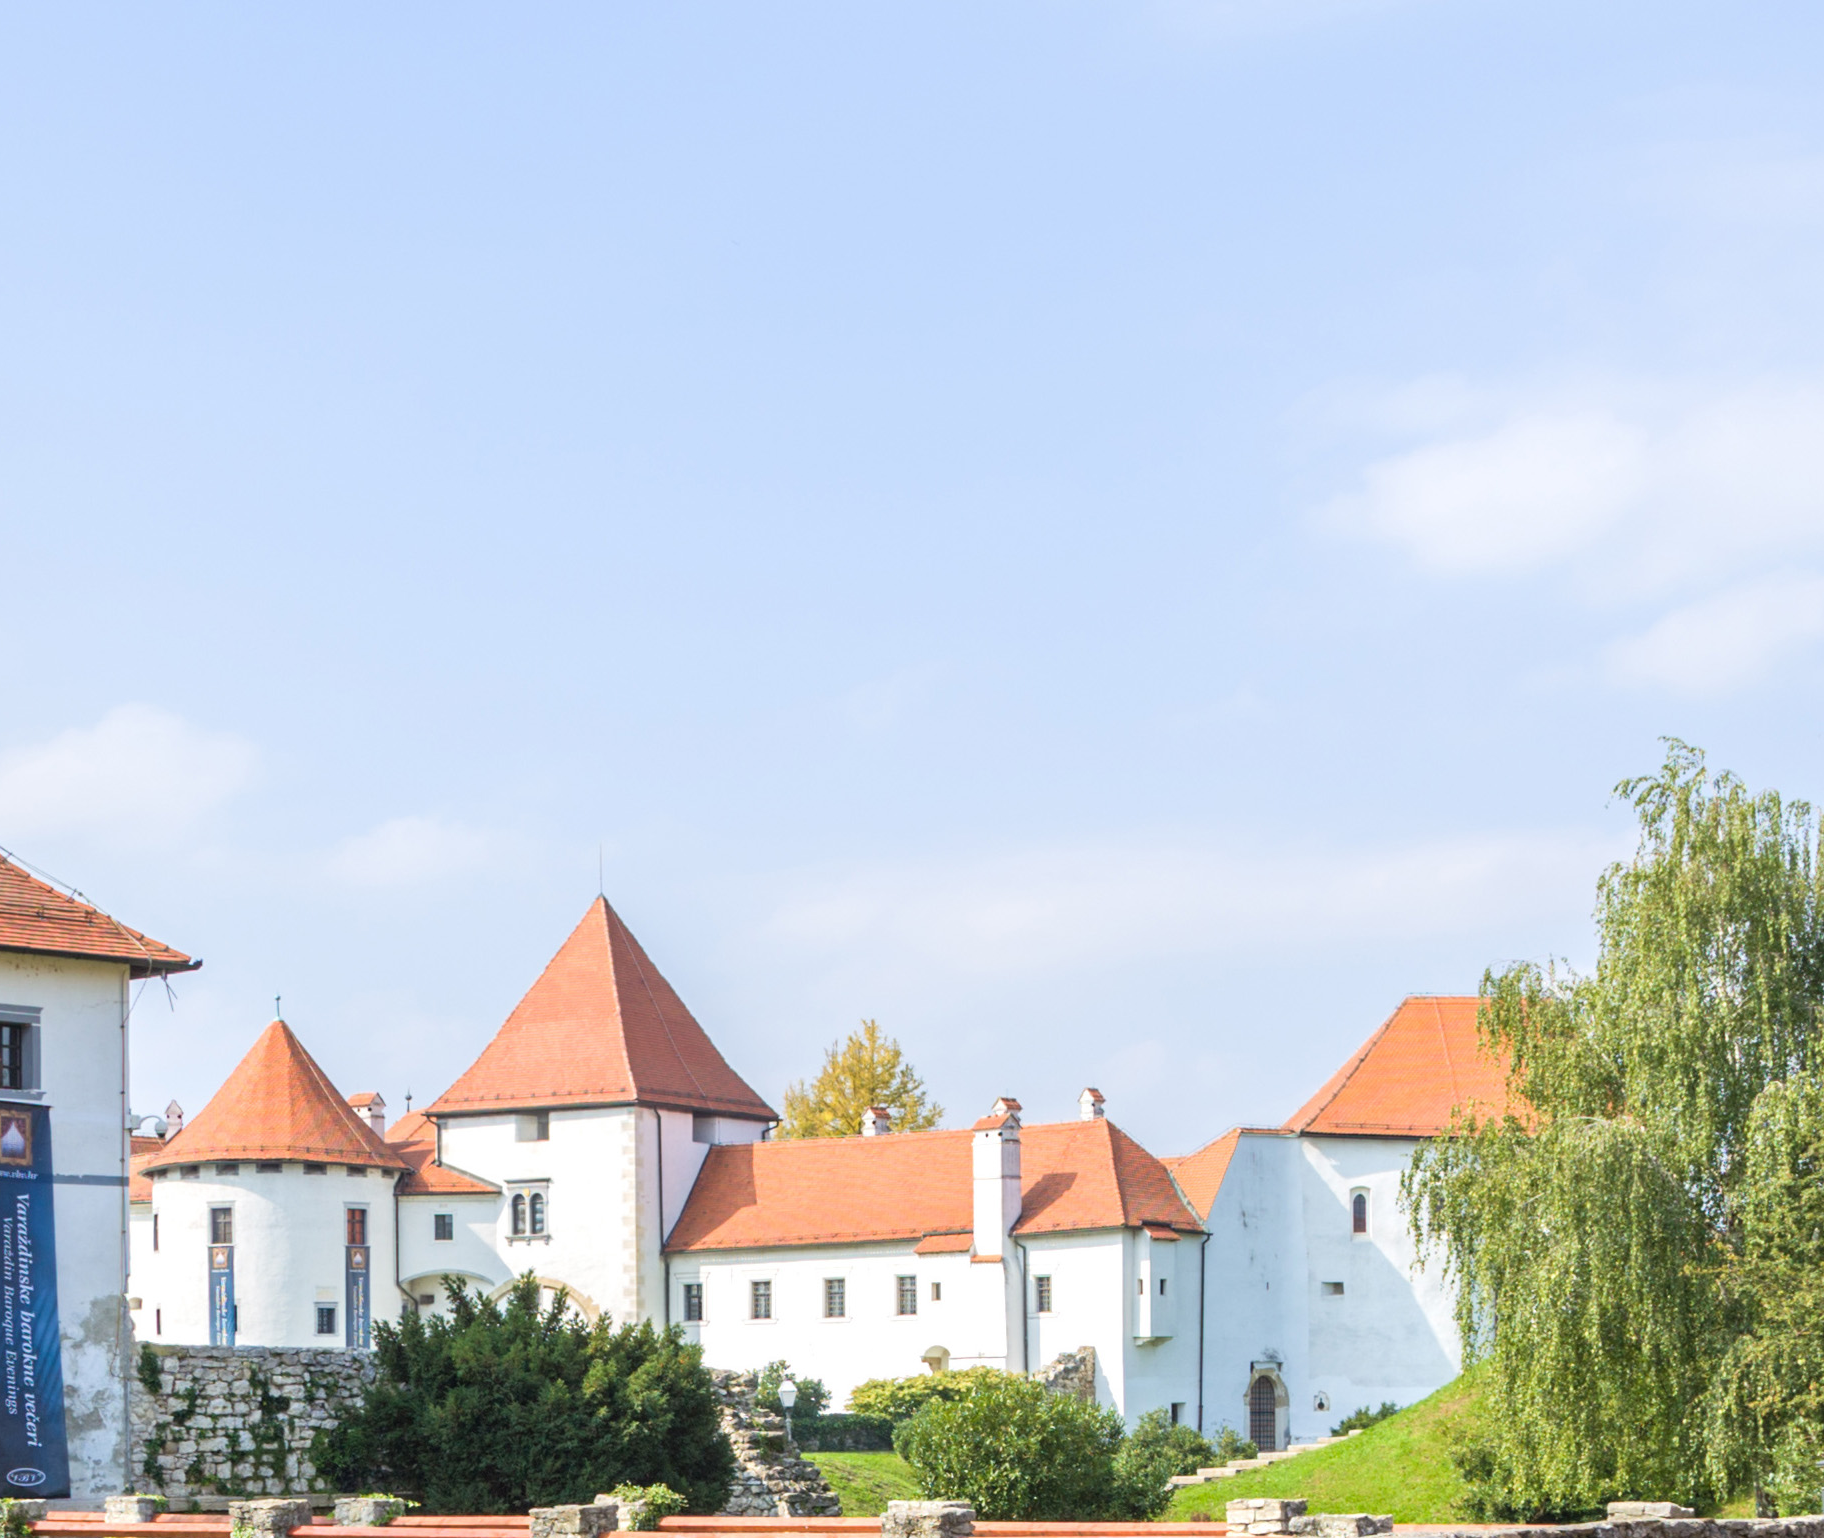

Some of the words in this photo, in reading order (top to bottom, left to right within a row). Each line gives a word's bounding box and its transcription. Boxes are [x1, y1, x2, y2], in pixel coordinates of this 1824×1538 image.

[3, 1217, 15, 1281] Varaždin
[17, 1193, 34, 1305] Varaždinske
[2, 1285, 16, 1346] Baroque
[20, 1310, 37, 1387] barokne
[5, 1350, 20, 1415] Evenings
[24, 1393, 43, 1447] večeri
